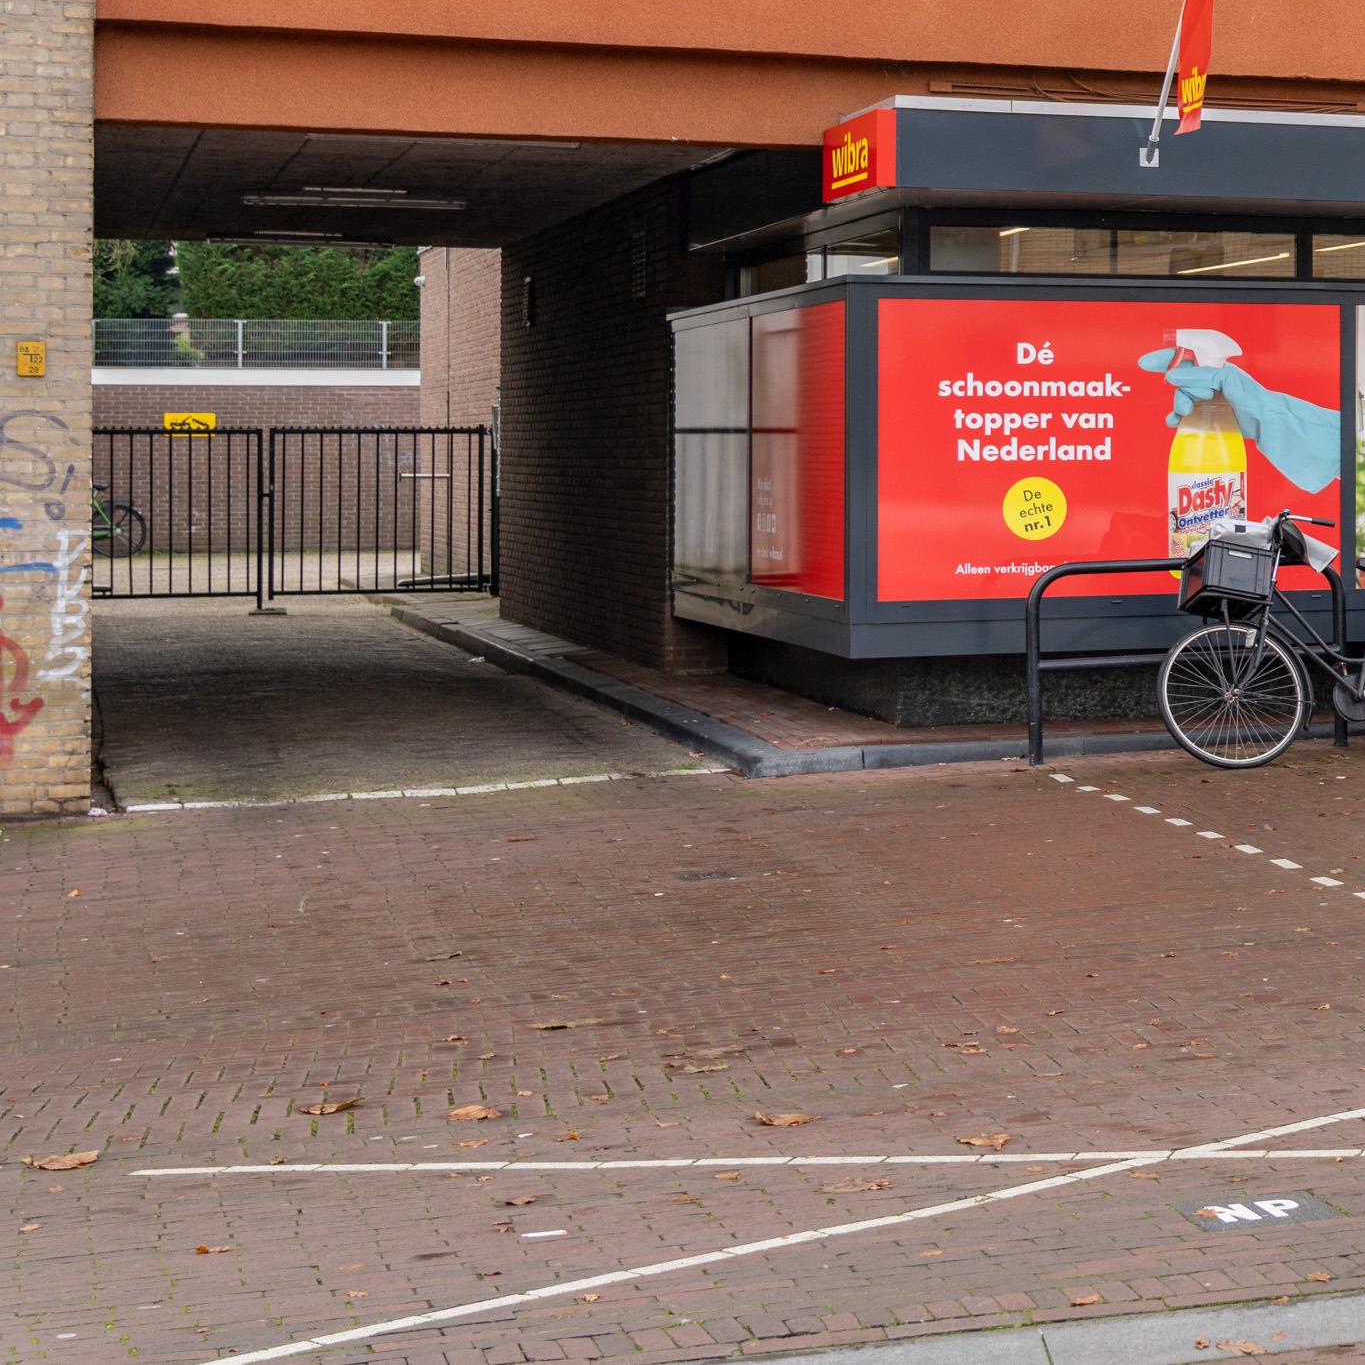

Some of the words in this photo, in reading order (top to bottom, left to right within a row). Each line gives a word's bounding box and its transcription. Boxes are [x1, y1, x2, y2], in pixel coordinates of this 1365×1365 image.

[831, 131, 868, 179] wibra
[1017, 341, 1054, 365] Dé
[938, 372, 1131, 397] schoonmaak-
[954, 409, 1052, 435] topper
[1061, 412, 1114, 429] van
[957, 437, 1112, 461] Nederland
[1023, 490, 1042, 502] De
[1191, 478, 1213, 490] classic
[1178, 479, 1234, 516] Dasty
[1019, 503, 1053, 518] echte
[1178, 507, 1231, 528] Ontvetter
[955, 563, 991, 575] Alleen
